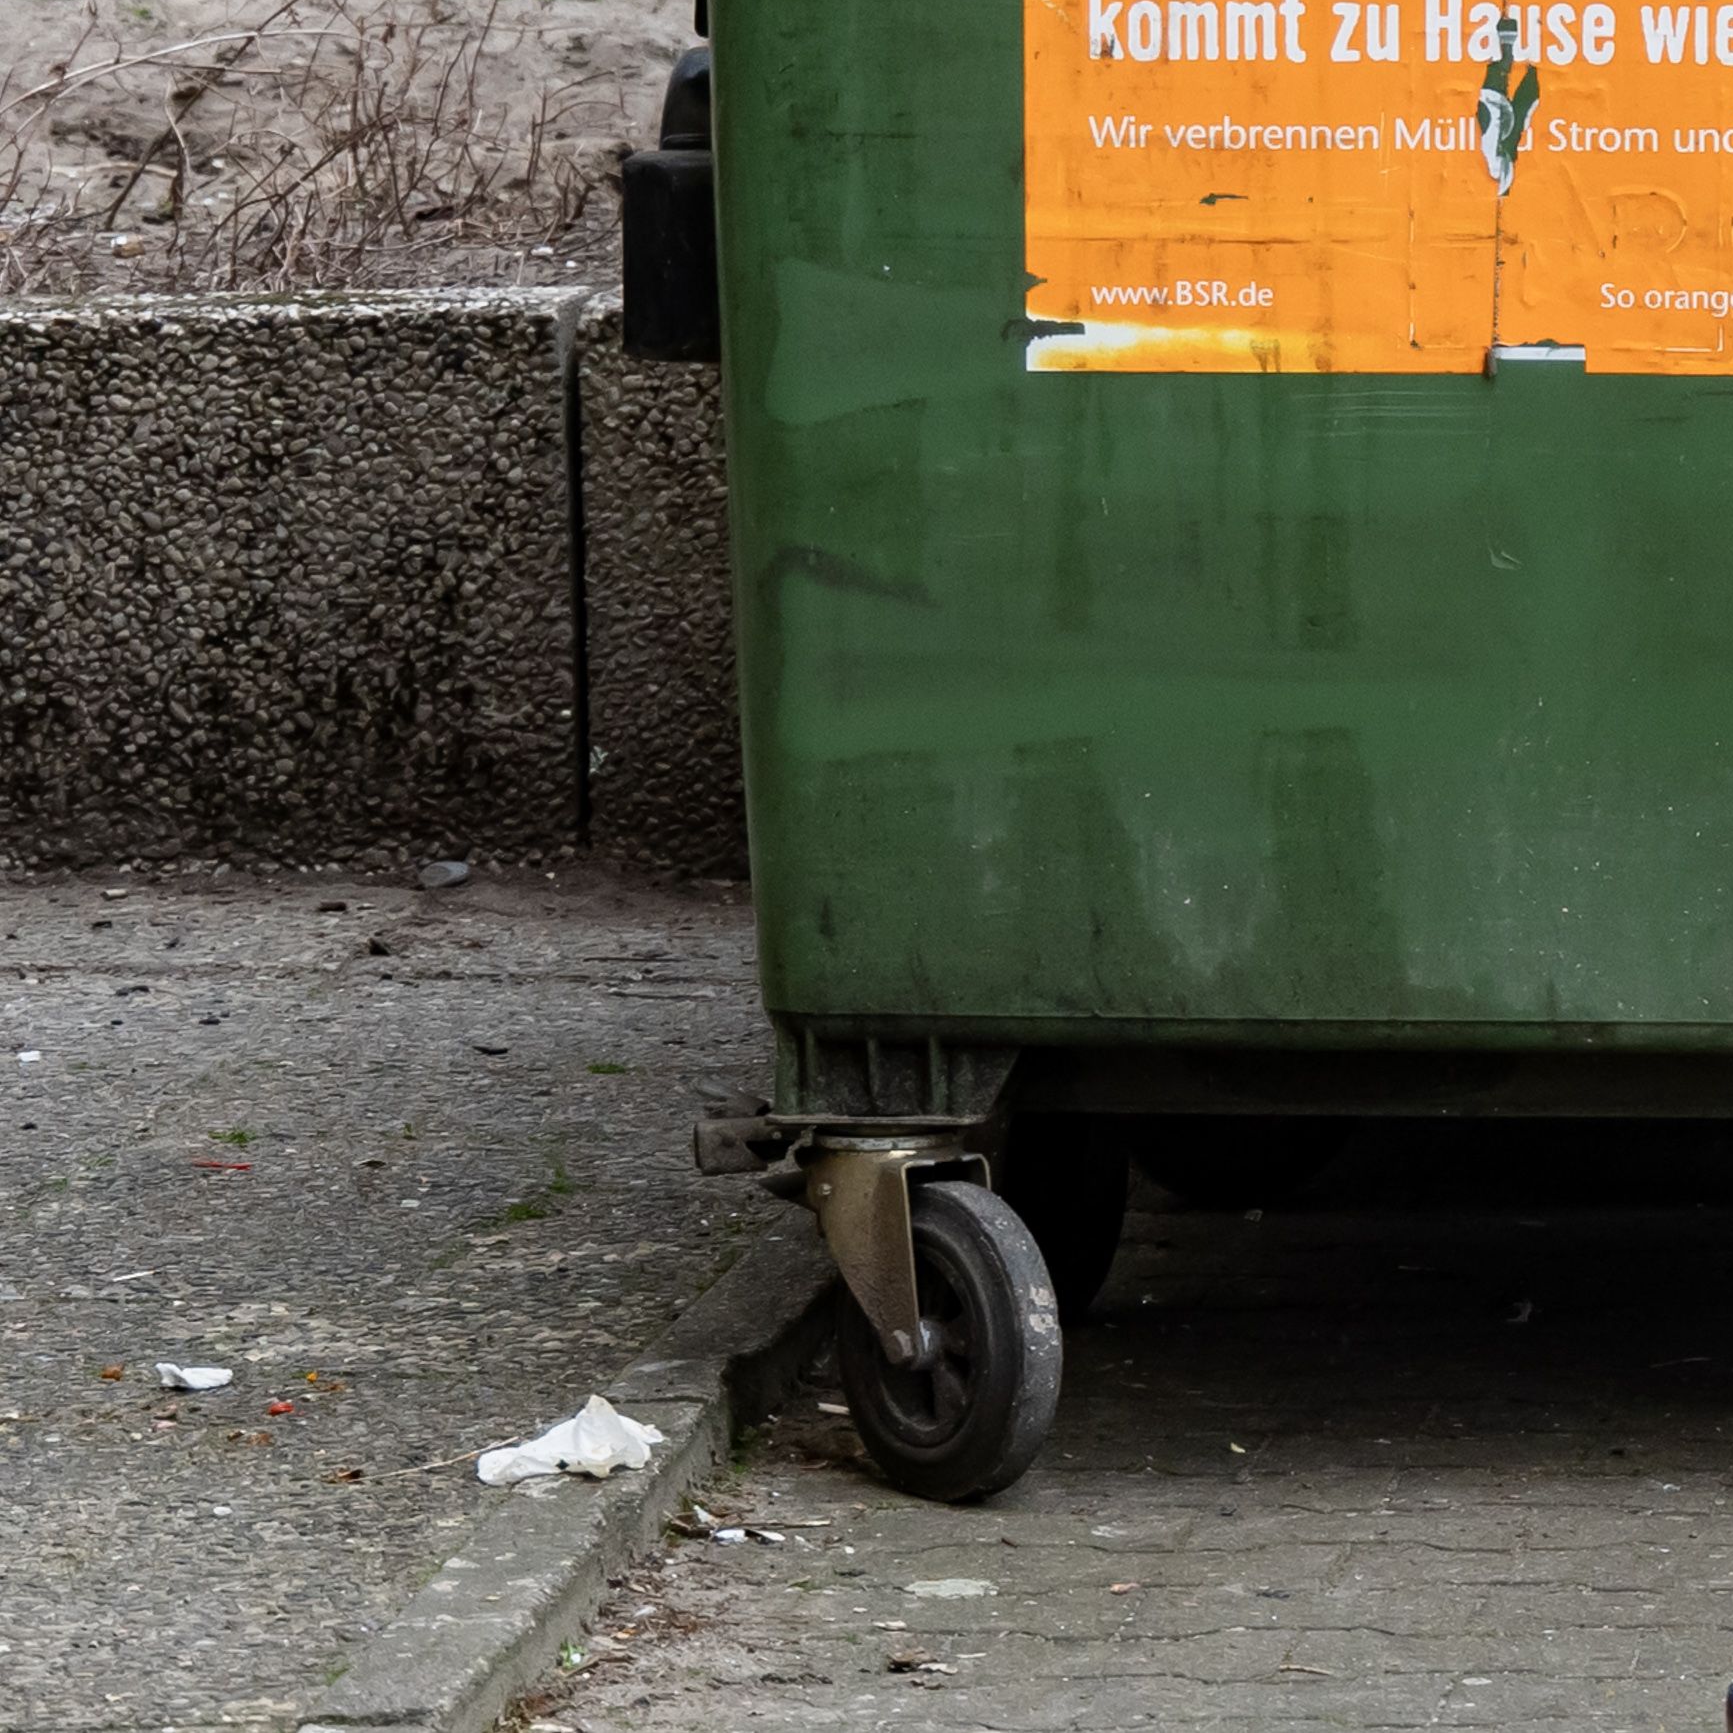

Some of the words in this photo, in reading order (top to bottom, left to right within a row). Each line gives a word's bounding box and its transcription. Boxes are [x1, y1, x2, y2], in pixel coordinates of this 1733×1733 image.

[1330, 1, 1400, 64] zu
[1088, 115, 1153, 149] Wir
[1164, 115, 1380, 151] verbrennen
[1395, 116, 1475, 152] Müll
[1548, 118, 1659, 154] Strom
[1091, 280, 1274, 308] www.BSR.de
[1601, 283, 1635, 309] So
